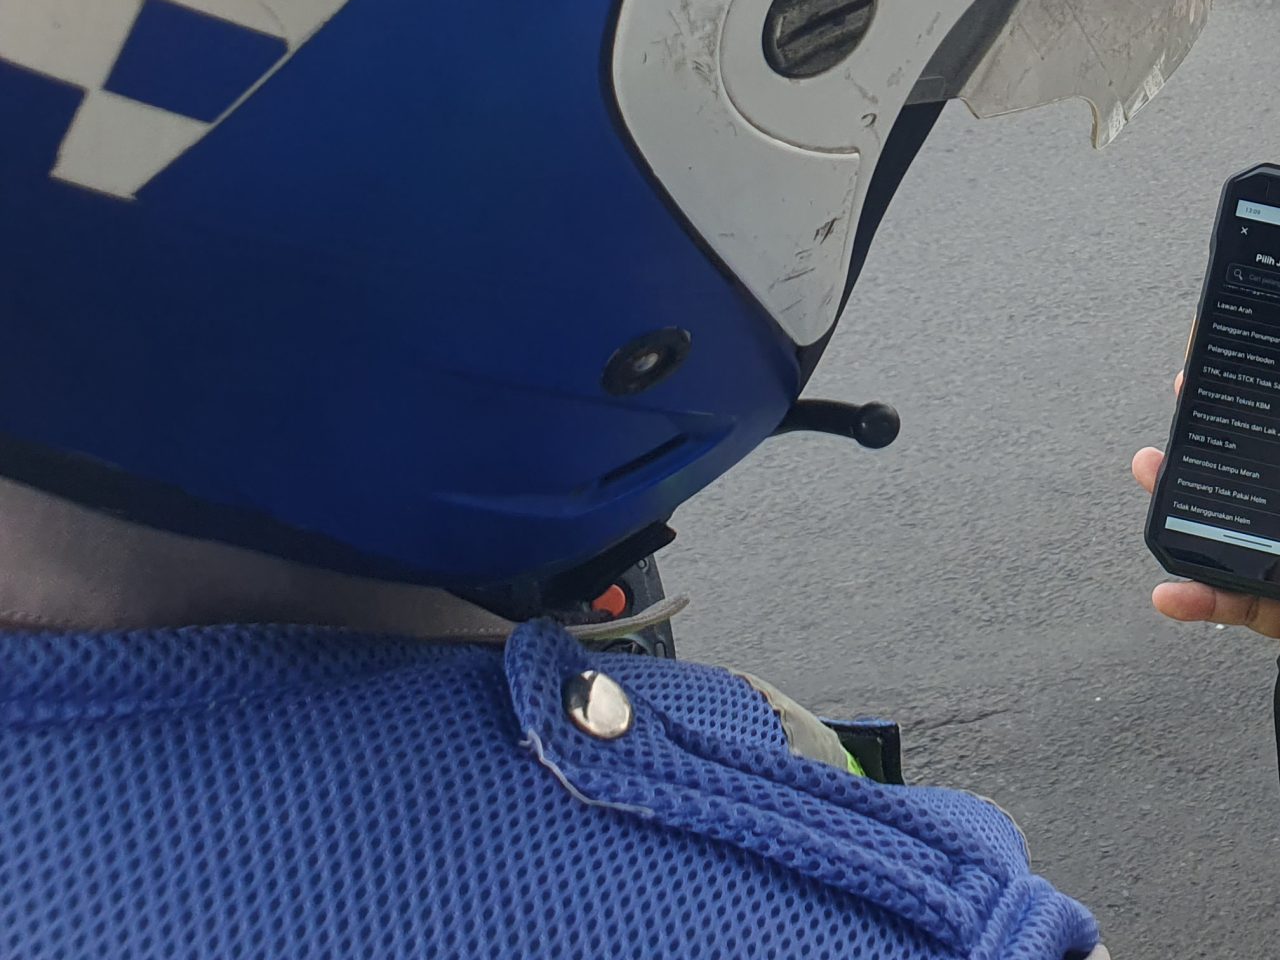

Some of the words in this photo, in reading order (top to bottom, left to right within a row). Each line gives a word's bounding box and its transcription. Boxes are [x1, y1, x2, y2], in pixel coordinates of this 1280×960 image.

[1256, 254, 1275, 266] Pilih
[1217, 301, 1238, 312] Lawan
[1238, 305, 1253, 315] Arah
[1212, 322, 1250, 337] Pelanggaran
[1207, 344, 1245, 359] Pelanggaran
[1246, 352, 1275, 365] Verboden
[1237, 373, 1255, 383] STCK
[1256, 378, 1272, 388] Tidak
[1198, 388, 1235, 402] Persyaratan
[1236, 397, 1255, 407] Teknis
[1256, 401, 1271, 410] KBM
[1192, 410, 1230, 424] Persyaratan
[1231, 419, 1250, 429] Teknis
[1251, 424, 1263, 432] dan
[1264, 426, 1277, 435] Laik
[1188, 432, 1206, 443] TNKB
[1207, 437, 1223, 447] Tidak
[1224, 441, 1237, 450] Sah
[1182, 455, 1217, 469] Menerobos
[1218, 463, 1239, 475] Lampu
[1240, 469, 1260, 479] Merah
[1177, 478, 1214, 493] Penumpang
[1215, 486, 1231, 496] Tidak
[1232, 491, 1250, 500] Pakai
[1250, 494, 1267, 504] Helm
[1173, 501, 1190, 511] Tidak
[1191, 505, 1234, 520] Menggunakan
[1235, 515, 1251, 525] Helm
